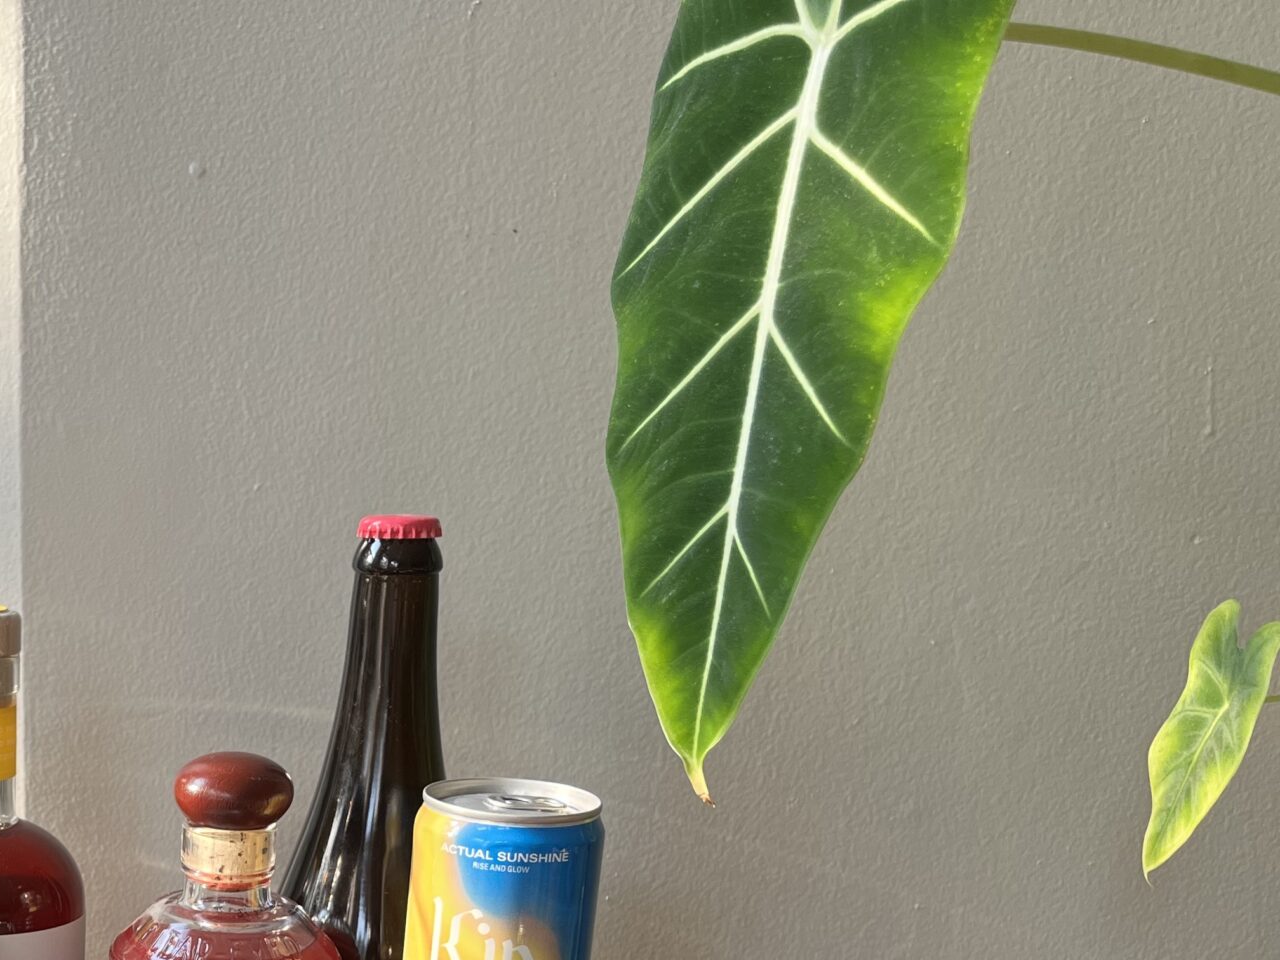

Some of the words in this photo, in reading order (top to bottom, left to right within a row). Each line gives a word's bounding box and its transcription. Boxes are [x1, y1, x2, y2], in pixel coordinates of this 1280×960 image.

[440, 842, 494, 861] ACTUAL
[496, 849, 570, 863] SUNSHINE
[472, 861, 489, 871] RISE
[489, 863, 507, 873] AND
[507, 865, 531, 874] GLOW
